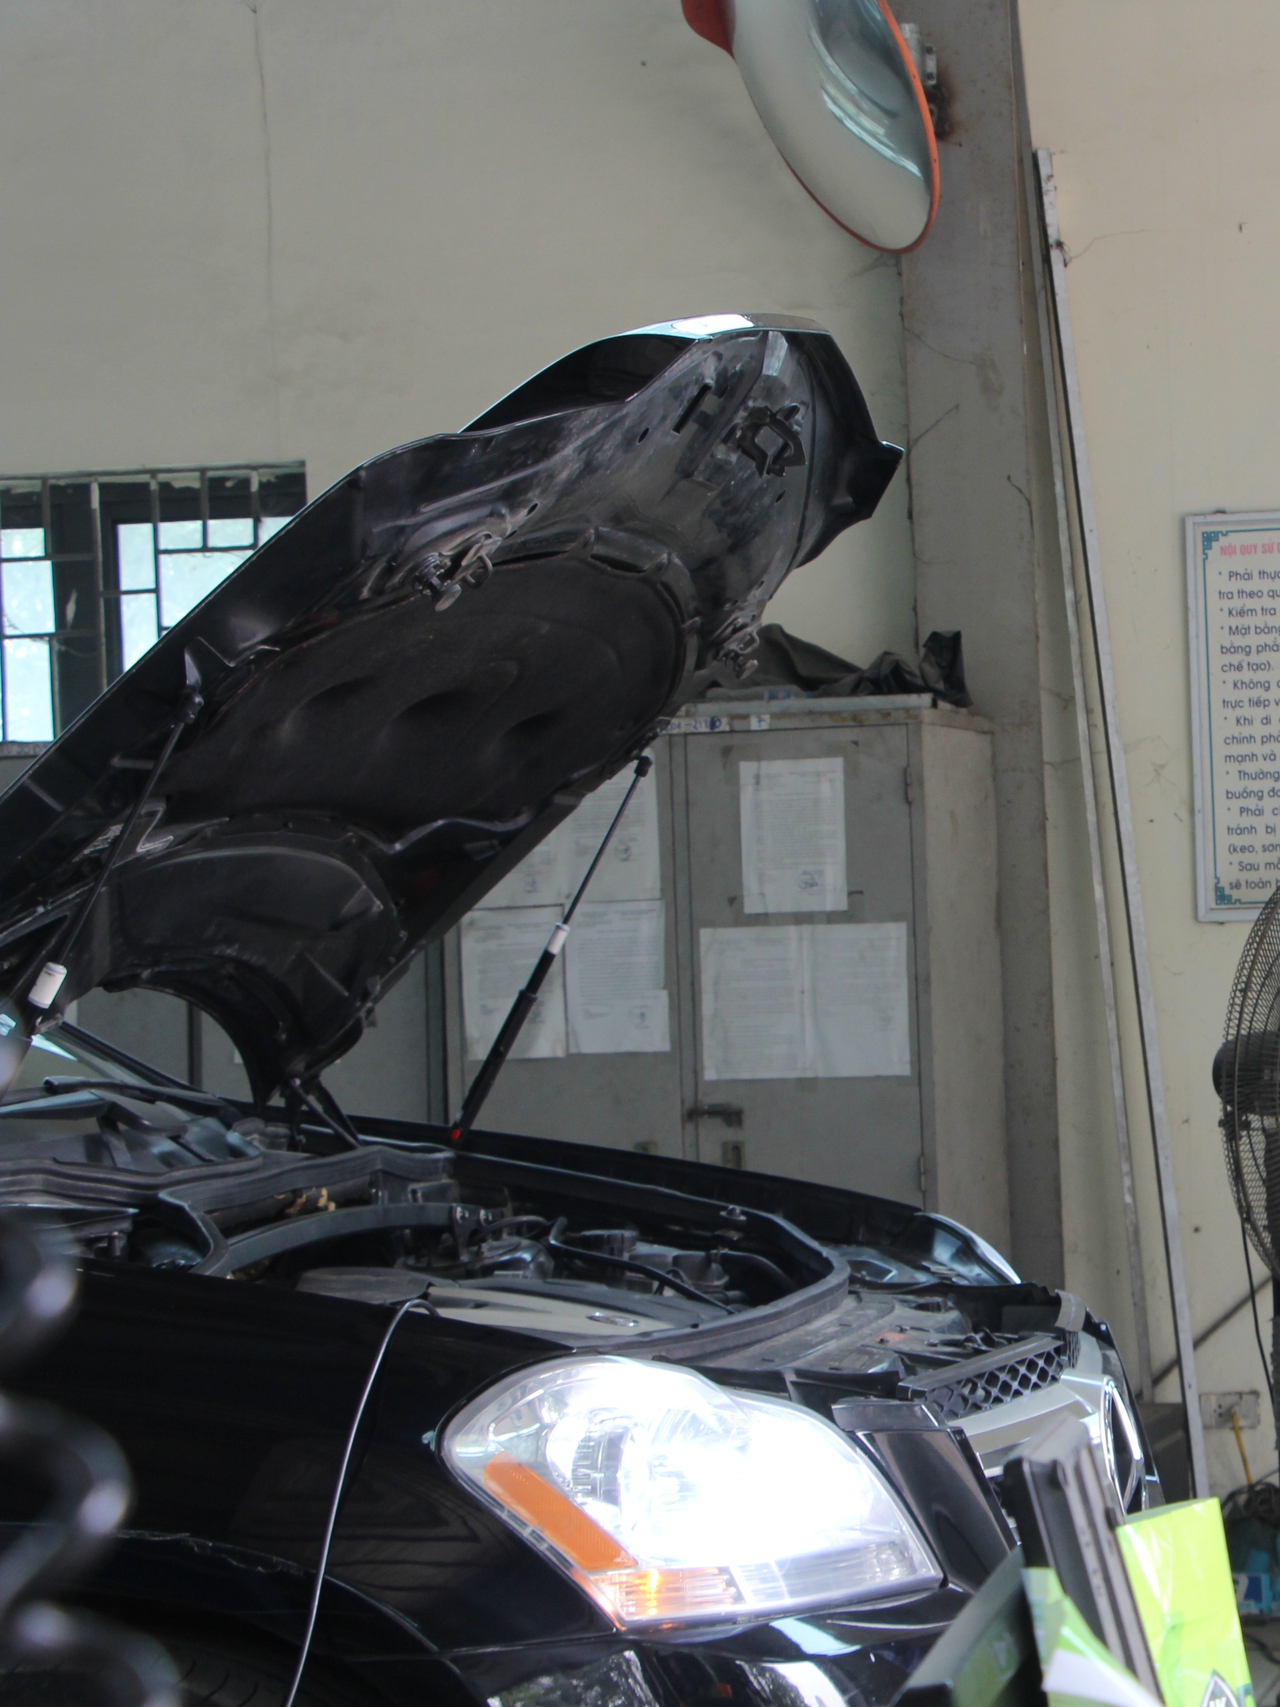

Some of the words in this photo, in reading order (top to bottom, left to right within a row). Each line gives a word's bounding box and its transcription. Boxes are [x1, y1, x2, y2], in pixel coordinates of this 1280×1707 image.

[1220, 543, 1237, 558] NỘI
[1240, 544, 1258, 556] QUY
[1228, 568, 1253, 581] Phải
[1219, 589, 1234, 600] tra
[1238, 589, 1263, 599] theo
[1228, 603, 1257, 617] Kiểm
[1261, 606, 1276, 616] tra
[1229, 624, 1250, 638] Mặt
[1221, 659, 1244, 672] chế
[1233, 678, 1270, 692] Không
[1222, 698, 1245, 711] trực
[1249, 695, 1270, 709] tiếp
[1236, 715, 1254, 726] Khi
[1261, 715, 1271, 725] di
[1224, 732, 1256, 745] chỉnh
[1224, 752, 1258, 765] mạnh
[1262, 749, 1276, 761] và
[1238, 768, 1280, 782] Thường
[1240, 804, 1264, 817] Phải
[1227, 824, 1257, 836] tránh
[1266, 823, 1276, 836] bị
[1239, 861, 1259, 872] Sau
[1246, 878, 1272, 889] toàn
